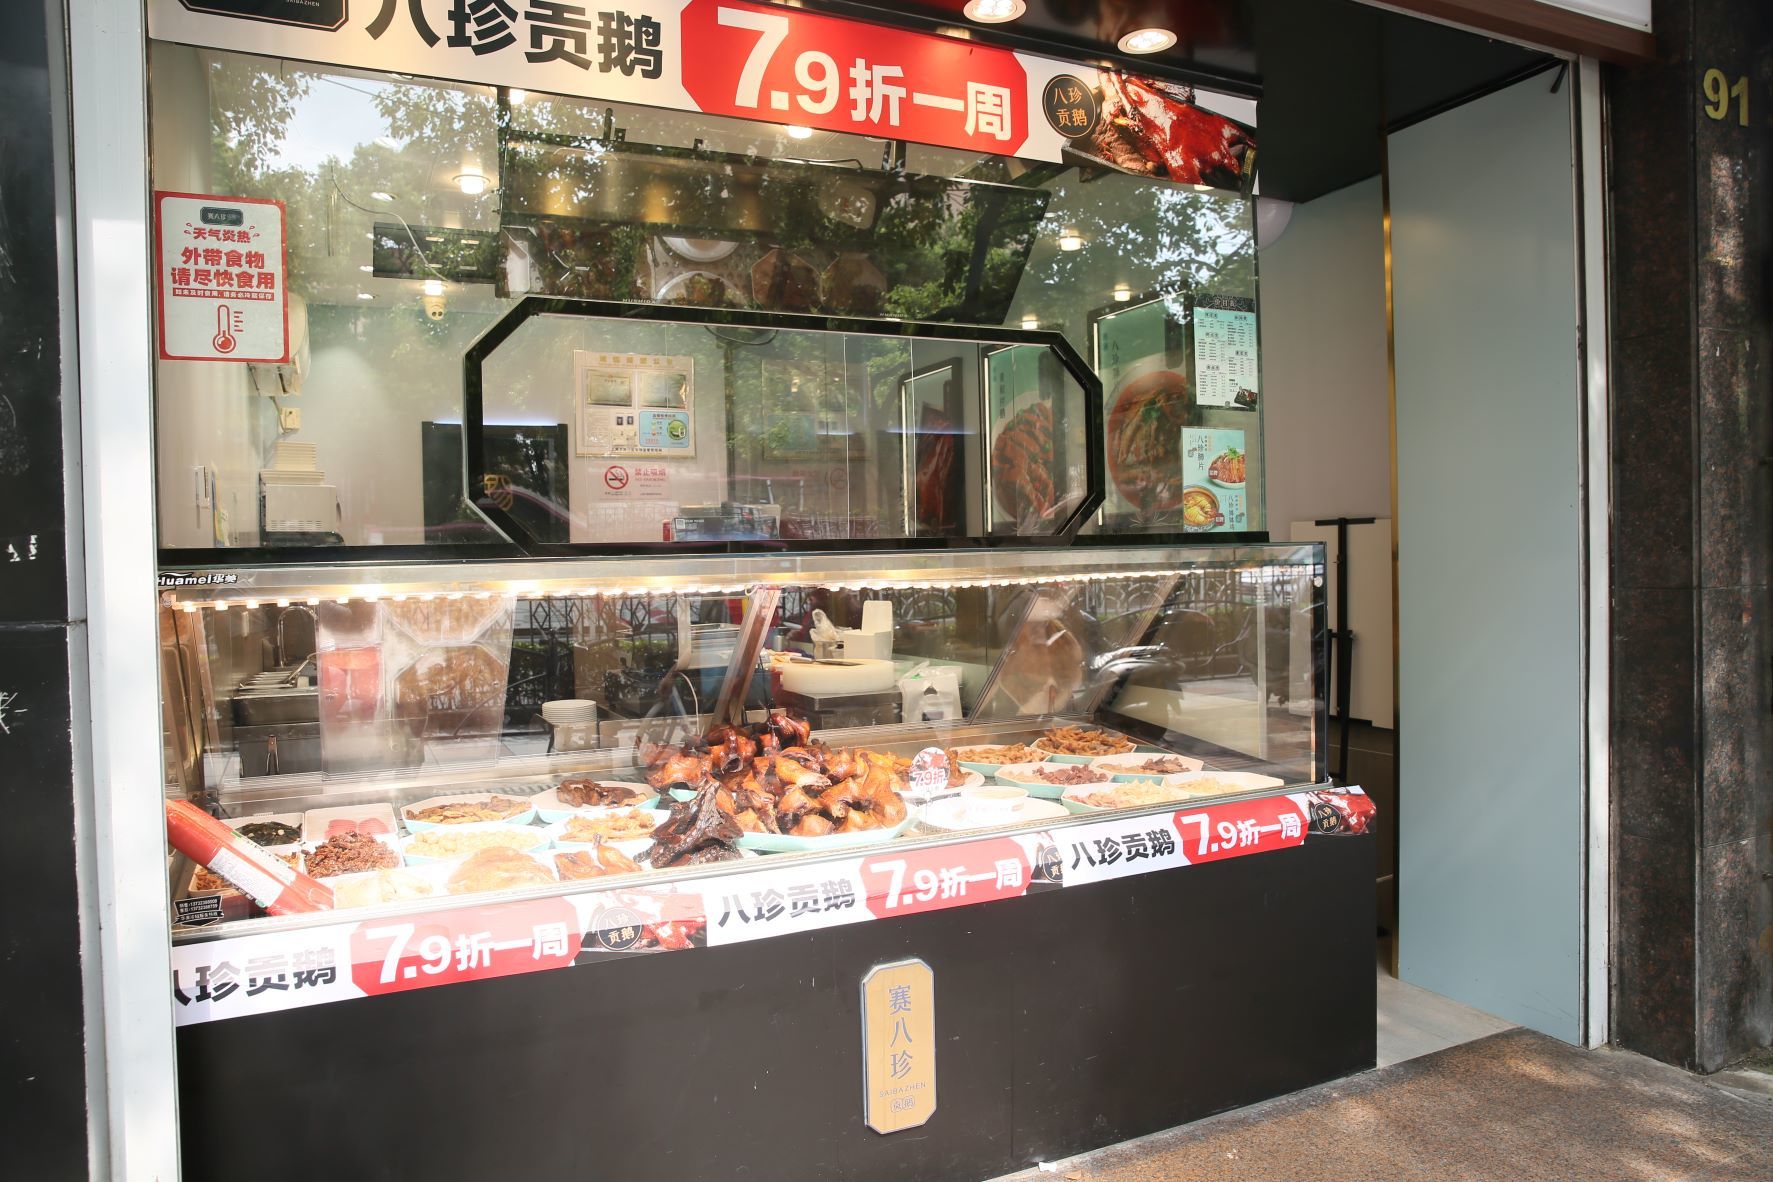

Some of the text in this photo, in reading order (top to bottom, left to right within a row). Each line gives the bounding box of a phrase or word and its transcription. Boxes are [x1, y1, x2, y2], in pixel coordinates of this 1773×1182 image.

[365, 0, 1012, 141] 八珍贡鹅 7.9折一周
[1053, 86, 1083, 105] 八珍
[1703, 68, 1749, 127] 91
[1056, 108, 1088, 127] 贡鹅
[193, 227, 251, 243] 天气炎热
[181, 246, 265, 269] 外带食物
[171, 267, 275, 289] 请尽快食用
[1071, 812, 1301, 871] 八珍贡鹅 7.9折一周
[718, 857, 1023, 928] 八珍贡鹅 7.9折一周
[608, 926, 635, 945] 贡鹅
[366, 921, 569, 984] 7.9折一周
[888, 985, 913, 1080] 赛八珍
[879, 1082, 927, 1098] SAIBAZHEN
